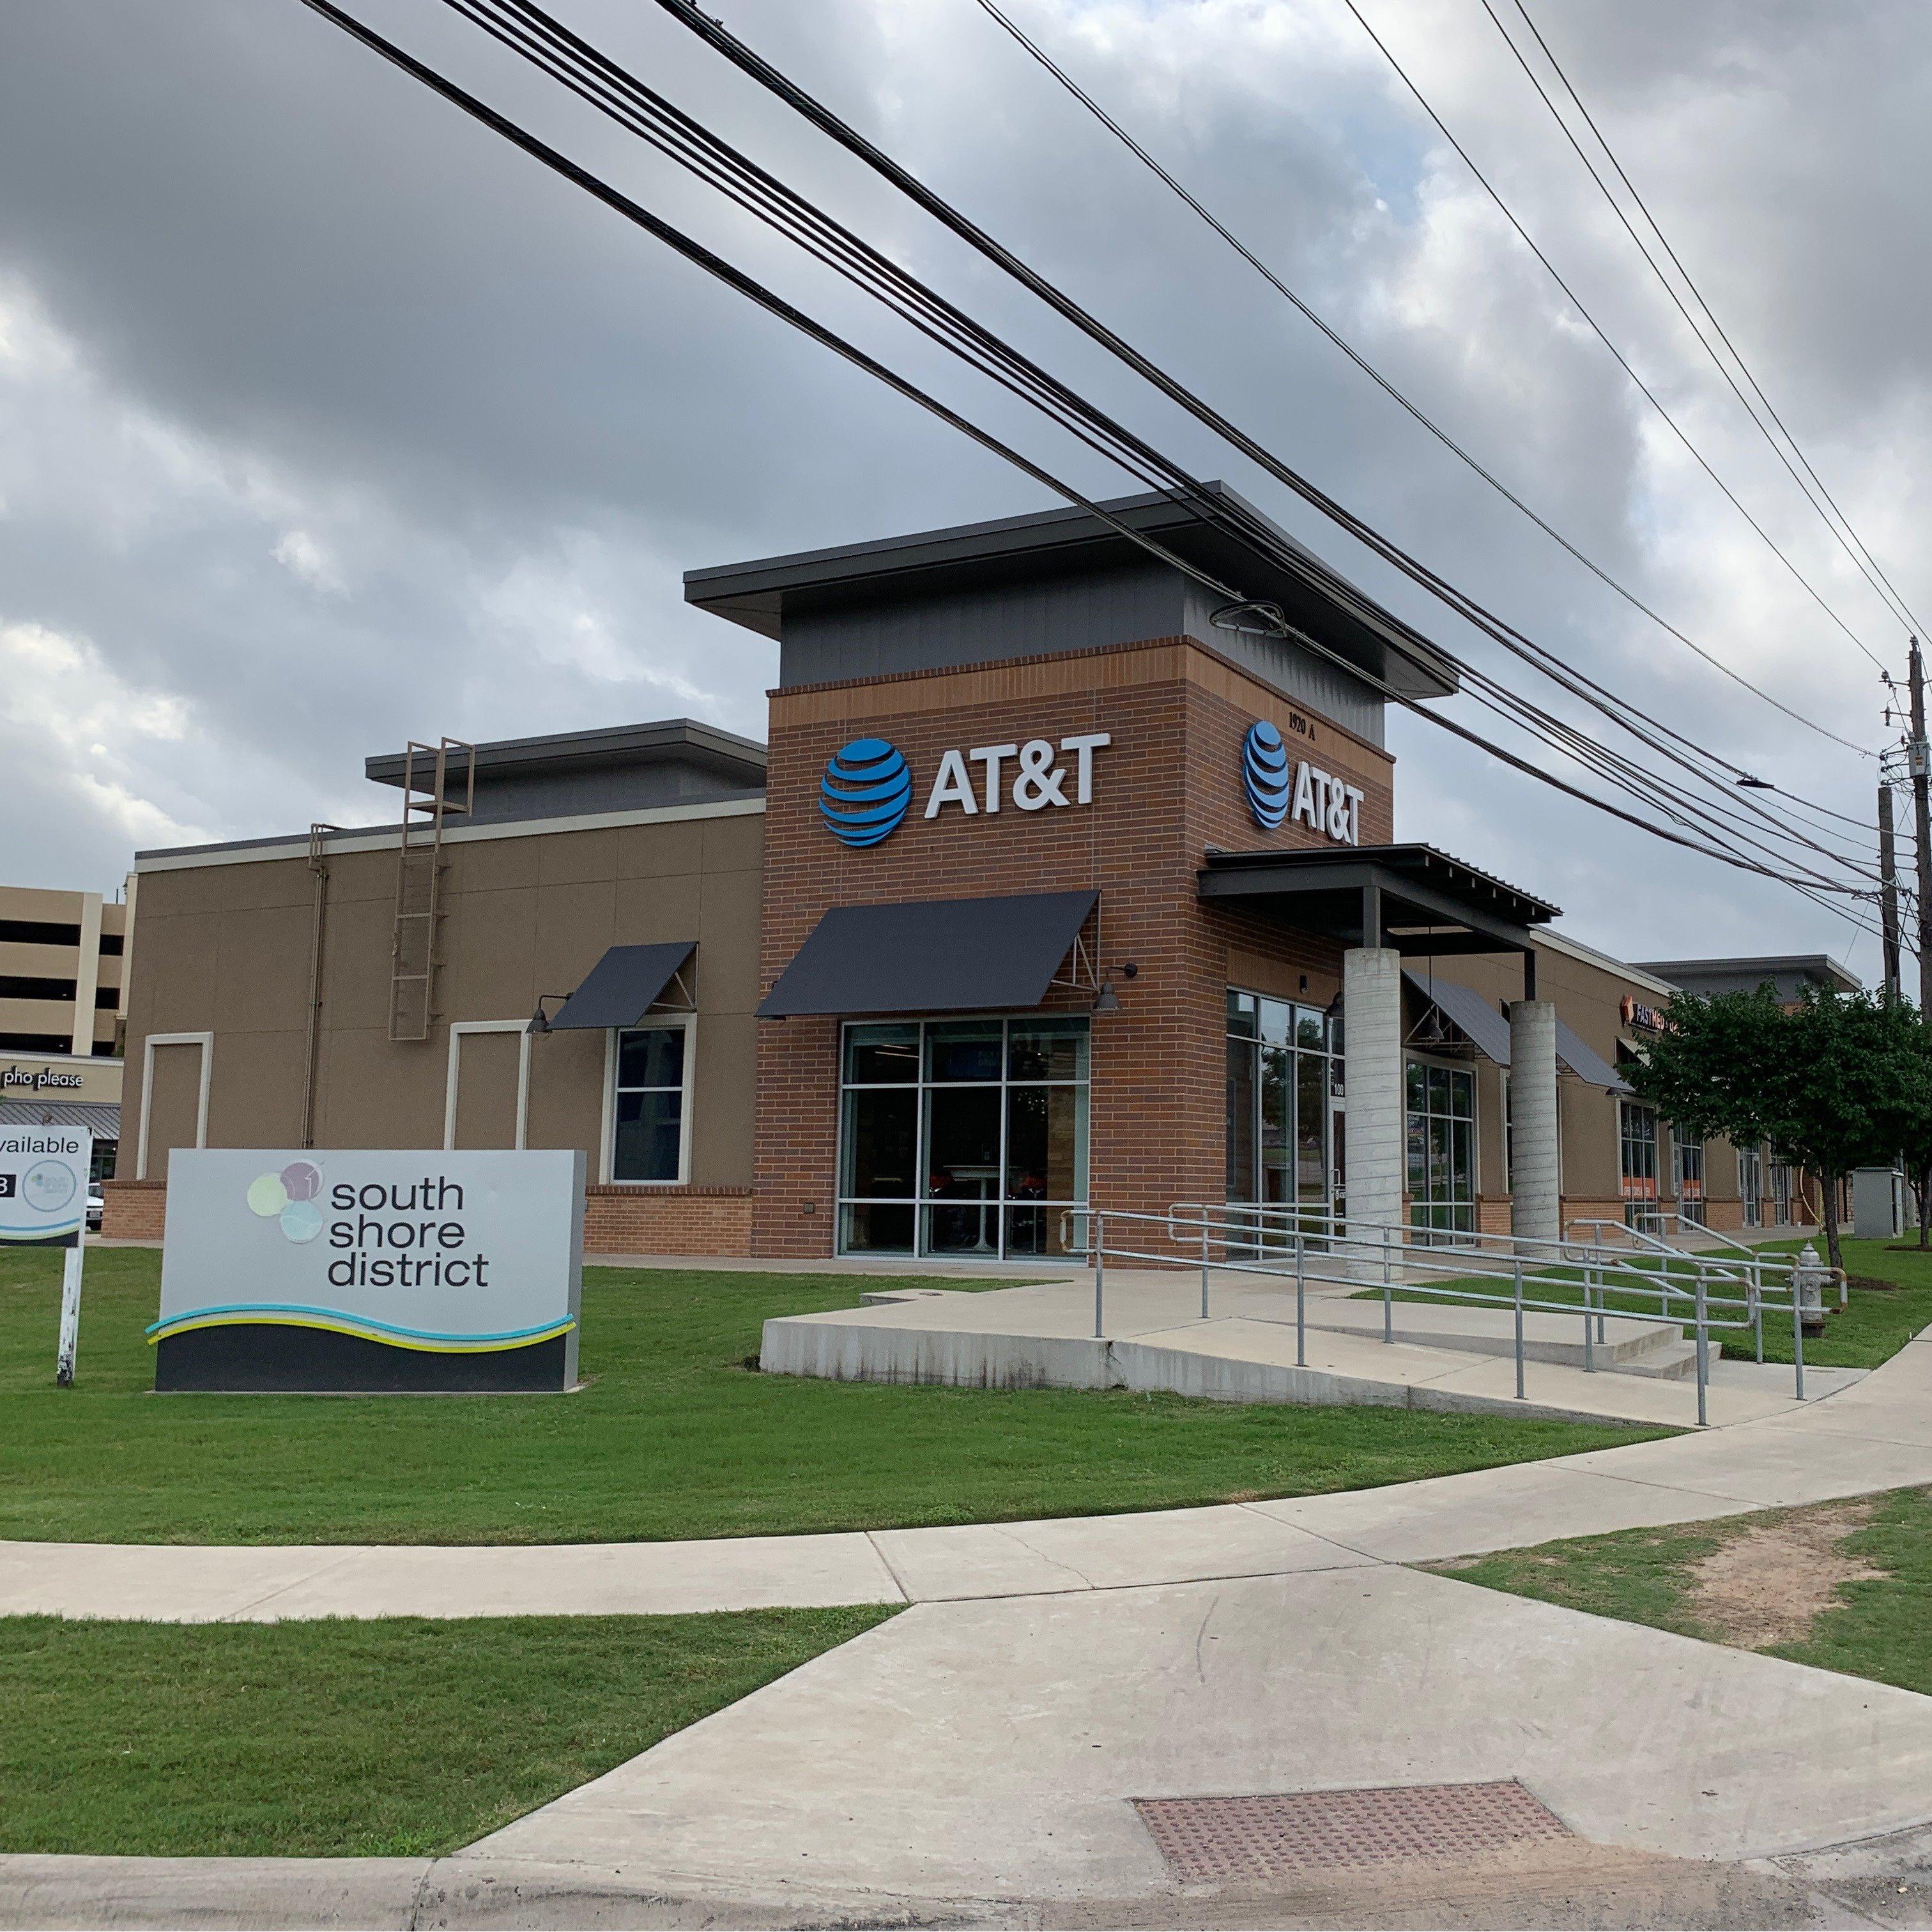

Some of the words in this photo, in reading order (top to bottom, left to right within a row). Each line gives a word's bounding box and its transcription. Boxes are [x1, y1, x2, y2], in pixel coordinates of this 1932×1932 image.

[1289, 712, 1306, 735] 1920
[1308, 723, 1315, 740] A
[924, 733, 1111, 819] AT&T
[1292, 761, 1364, 847] AT&T
[4, 1066, 33, 1087] pho
[37, 1068, 84, 1090] please
[331, 1176, 463, 1211] south
[329, 1214, 465, 1248] shore
[328, 1252, 489, 1287] district
